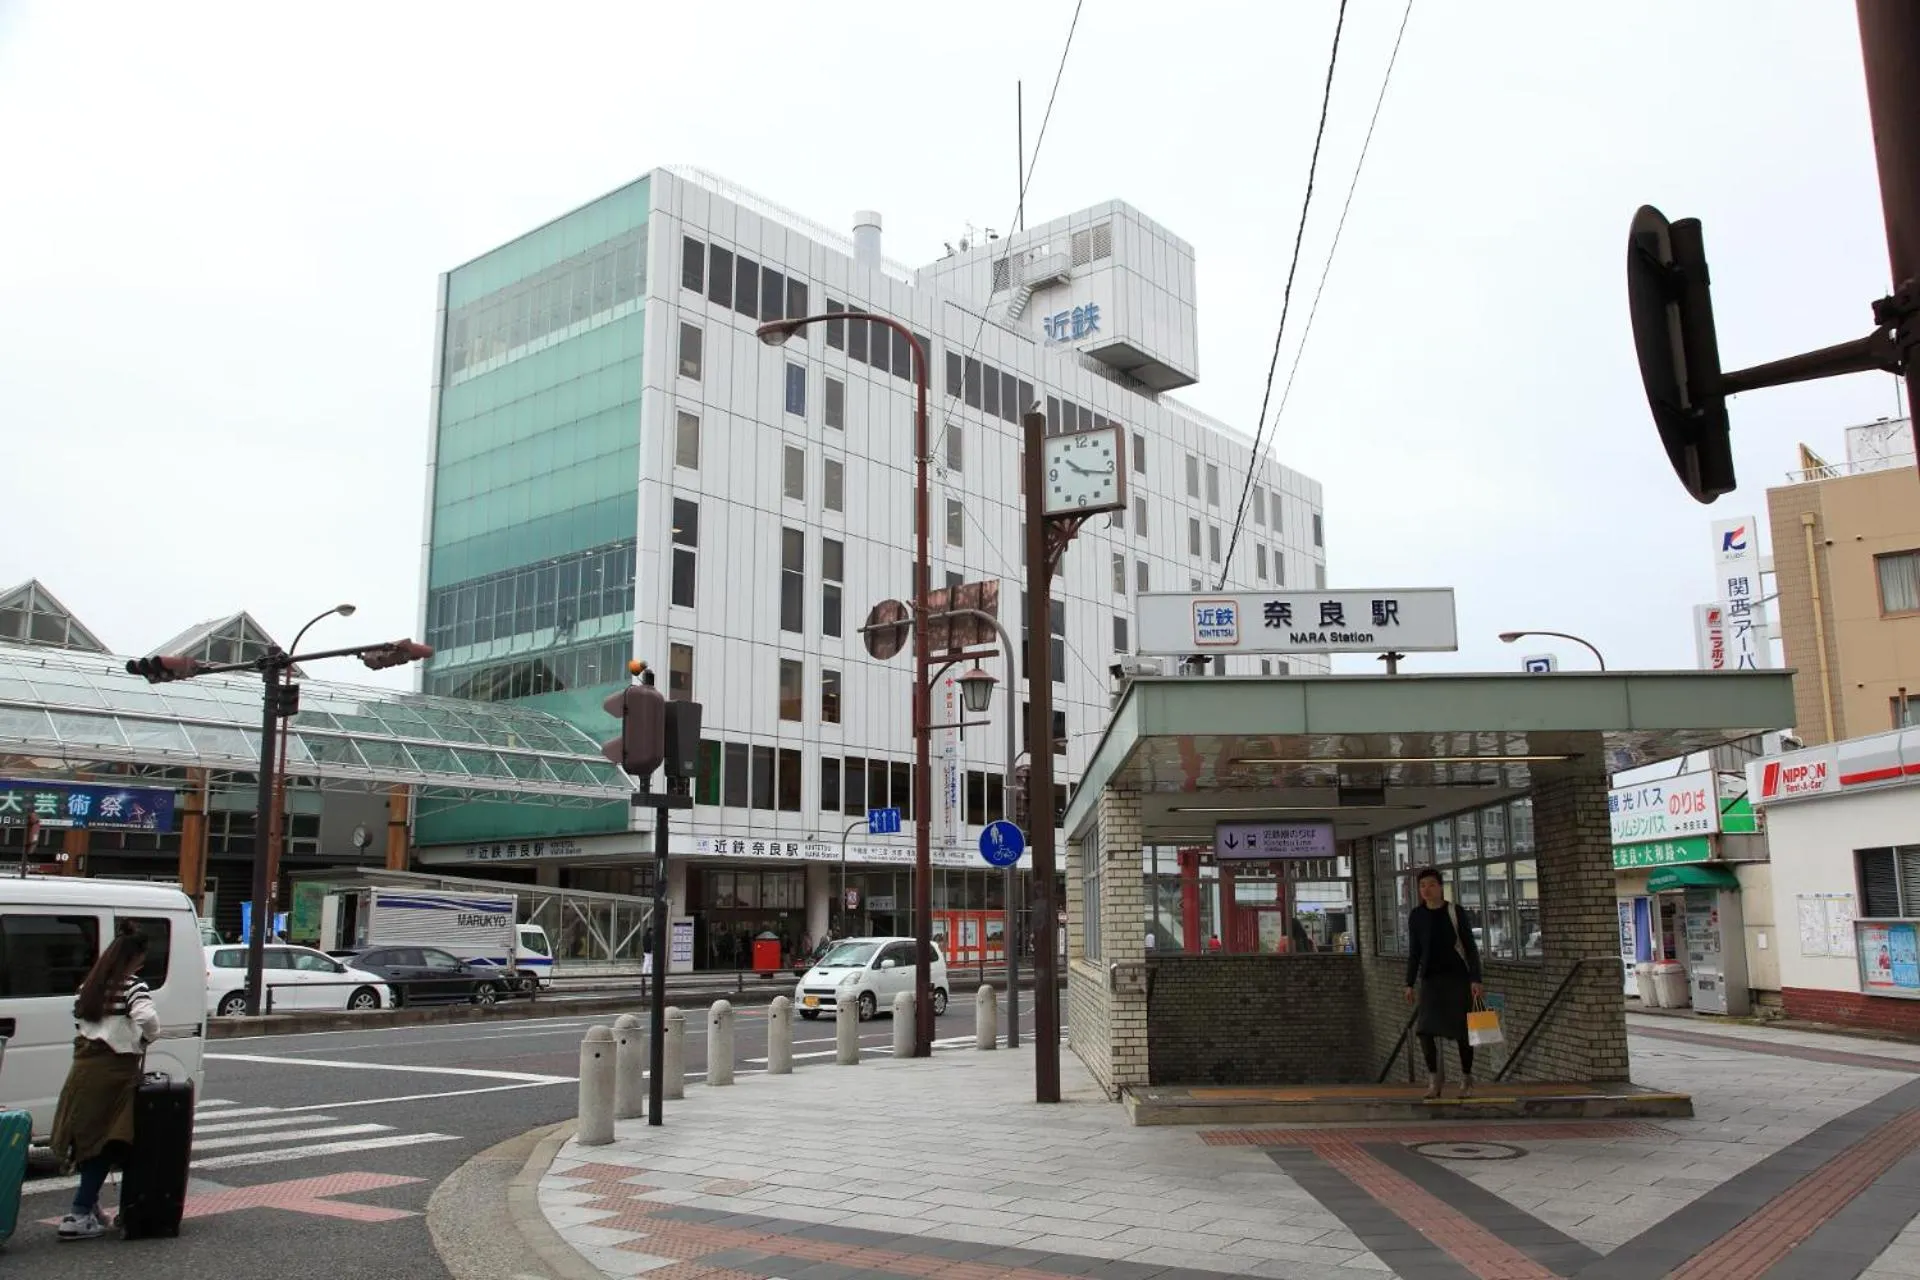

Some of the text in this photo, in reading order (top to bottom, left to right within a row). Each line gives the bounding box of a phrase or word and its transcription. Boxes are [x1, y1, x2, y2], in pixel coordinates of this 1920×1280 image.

[1043, 303, 1100, 342] 近鉄
[1075, 435, 1087, 448] 12
[1049, 469, 1058, 482] 9
[1106, 461, 1115, 473] 3
[1078, 494, 1087, 507] 6
[1197, 607, 1235, 627] 近鉄
[1263, 600, 1400, 629] 奈良駅
[1199, 629, 1235, 638] KINTETSU
[1289, 630, 1374, 644] NARA Station
[1783, 763, 1826, 783] NIPPON
[0, 791, 123, 817] 大芸術祭
[1608, 788, 1664, 812] 観光バス
[1669, 789, 1706, 815] のりば
[479, 841, 545, 859] 近鉄奈良駅
[714, 840, 798, 857] 近鉄奈良駅
[457, 914, 507, 927] MARUKYO
